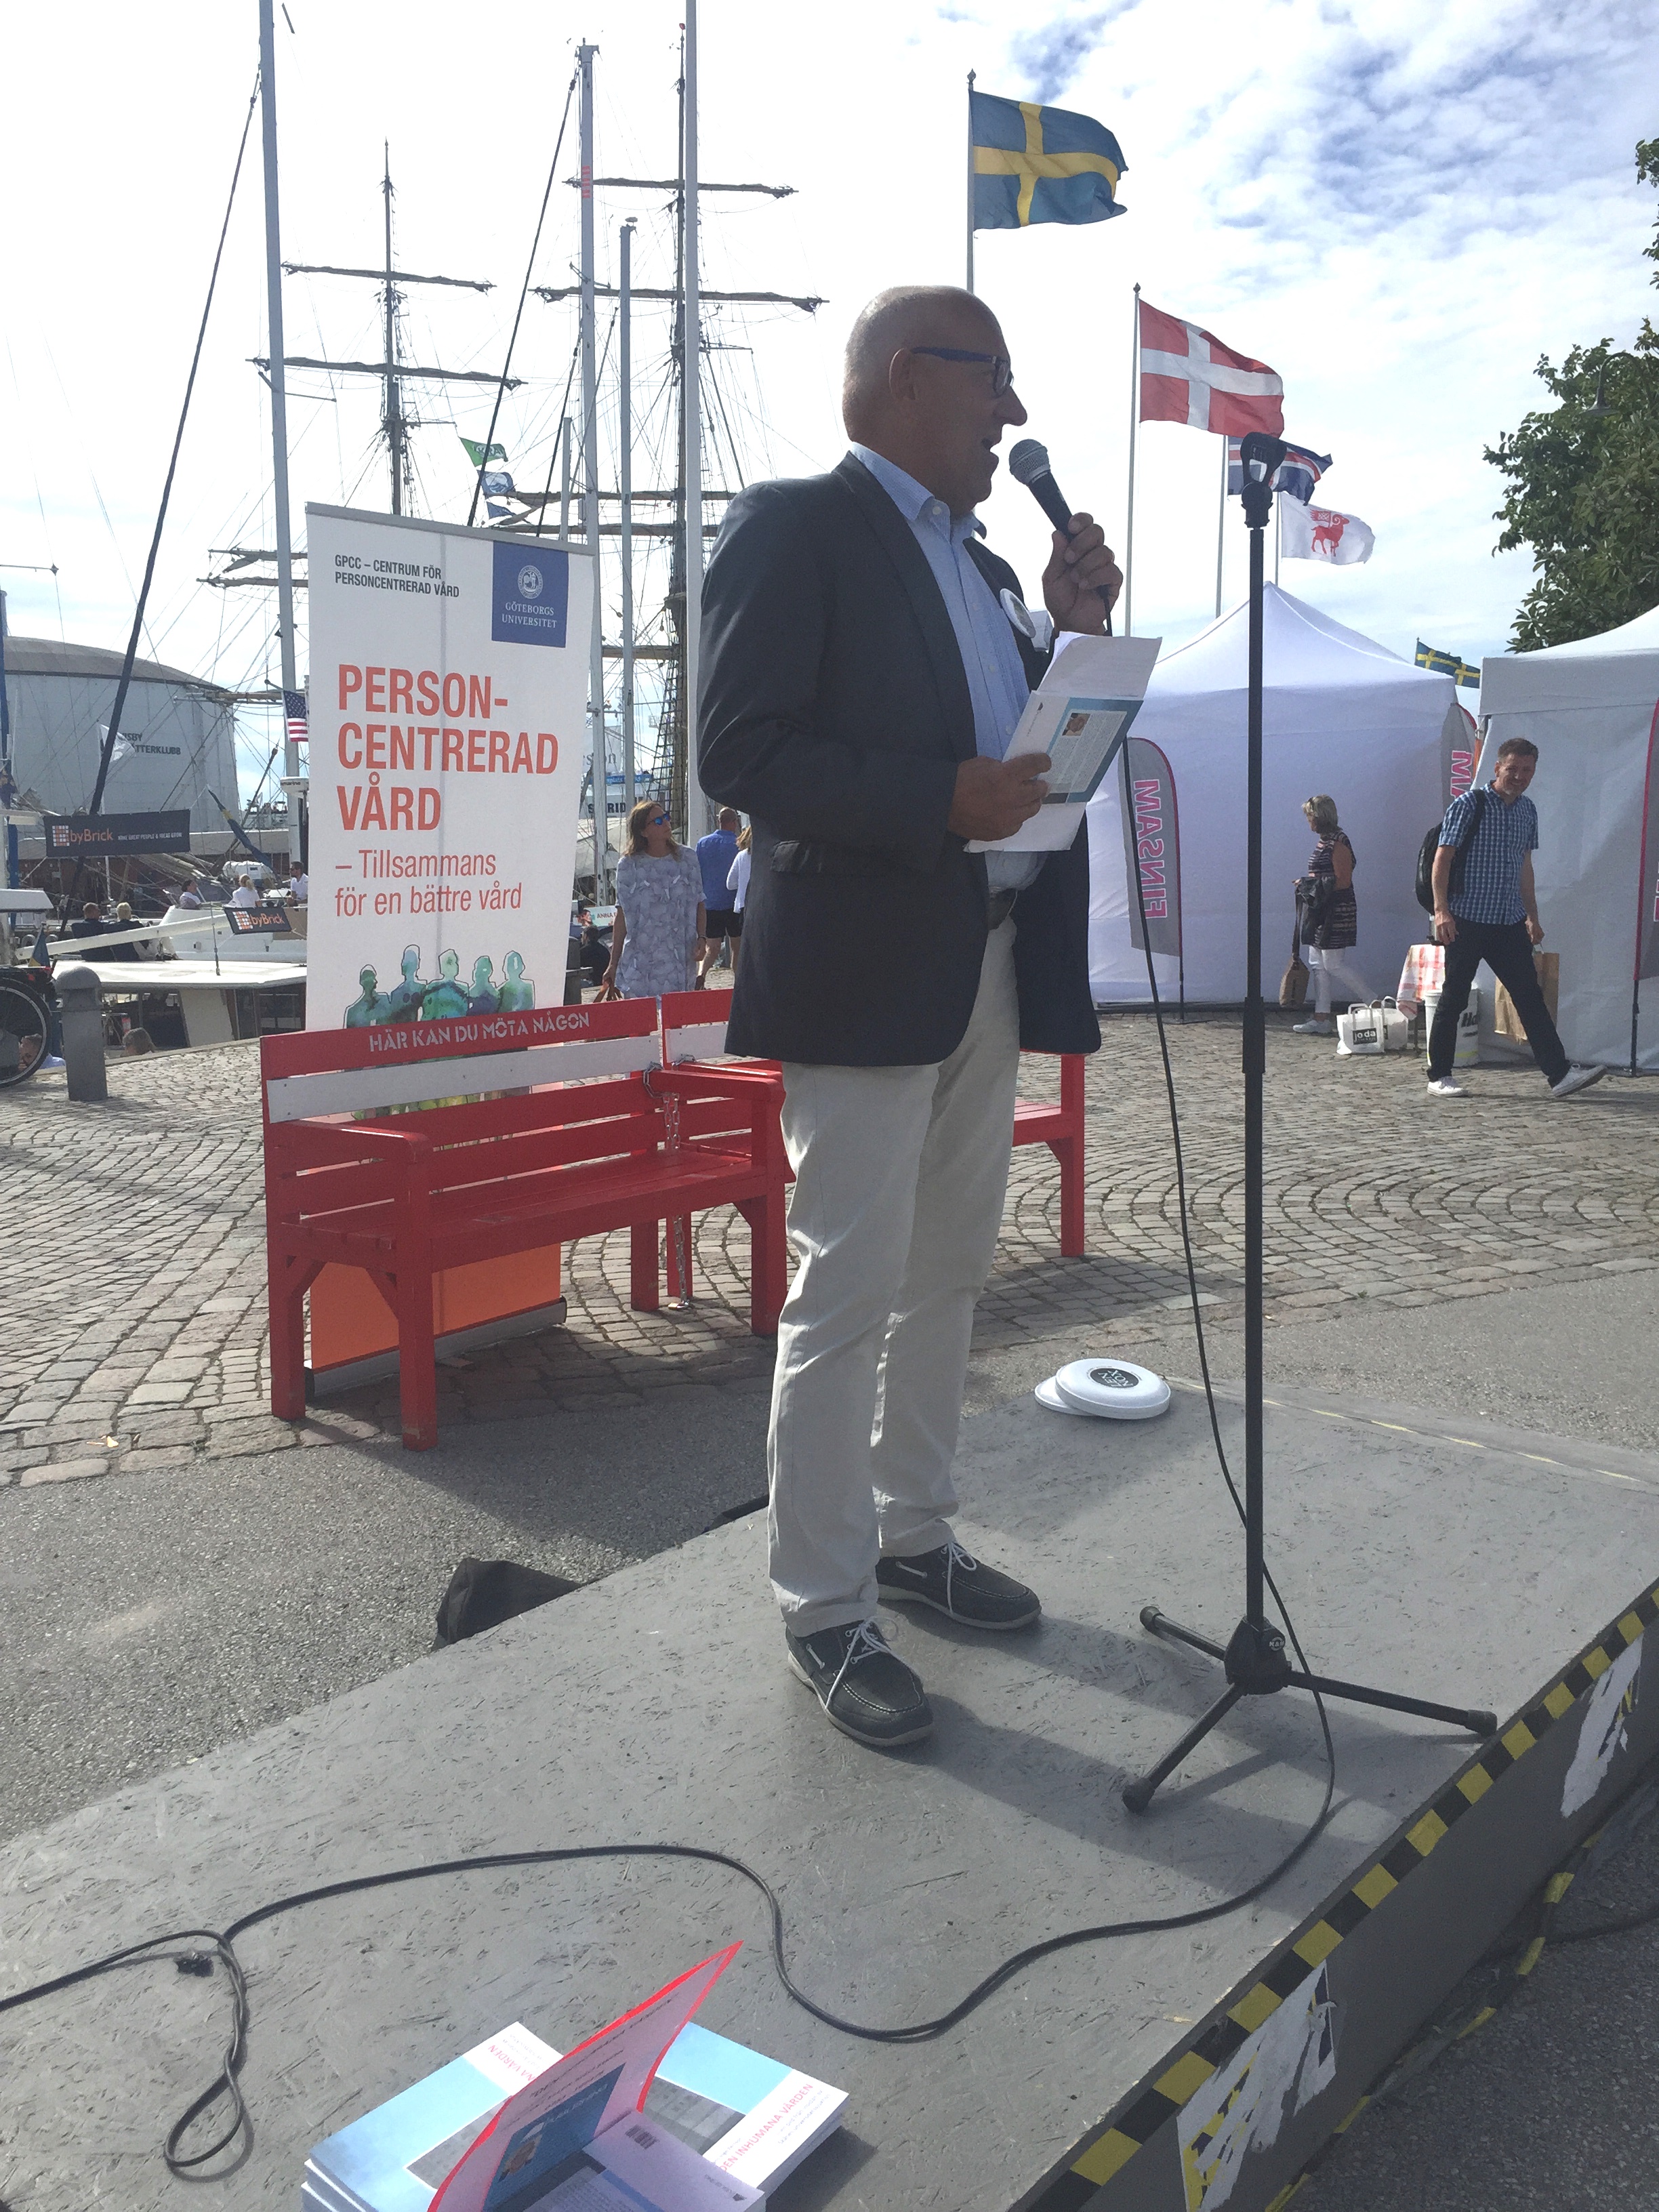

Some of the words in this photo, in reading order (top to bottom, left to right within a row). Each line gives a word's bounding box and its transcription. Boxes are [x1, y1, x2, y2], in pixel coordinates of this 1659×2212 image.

[335, 554, 361, 569] GPCC
[373, 560, 420, 576] CENTRUM
[423, 565, 441, 579] FÖR
[335, 571, 431, 594] PERSONCENTRERAD
[434, 581, 459, 598] VÅRD
[501, 614, 557, 628] UNIVERSITET
[505, 601, 554, 616] GÖTEBORGS
[338, 663, 508, 719] PERSON-
[338, 722, 558, 775] CENTRERAD
[336, 771, 441, 831] VÅRD
[70, 828, 113, 845] byBrick
[358, 849, 496, 878] Tillsammans
[335, 887, 367, 917] för
[374, 892, 401, 916] en
[410, 884, 472, 914] bättre
[479, 880, 523, 911] vård
[249, 913, 285, 927] byBrick
[369, 1029, 408, 1052] HÄR
[412, 1026, 450, 1047] KAN
[455, 1024, 478, 1043] DU
[482, 1018, 529, 1040] MÖTA
[533, 1010, 590, 1033] NÅGON
[735, 2114, 783, 2156] INHUMANA
[779, 2083, 813, 2114] VÅRDEN
